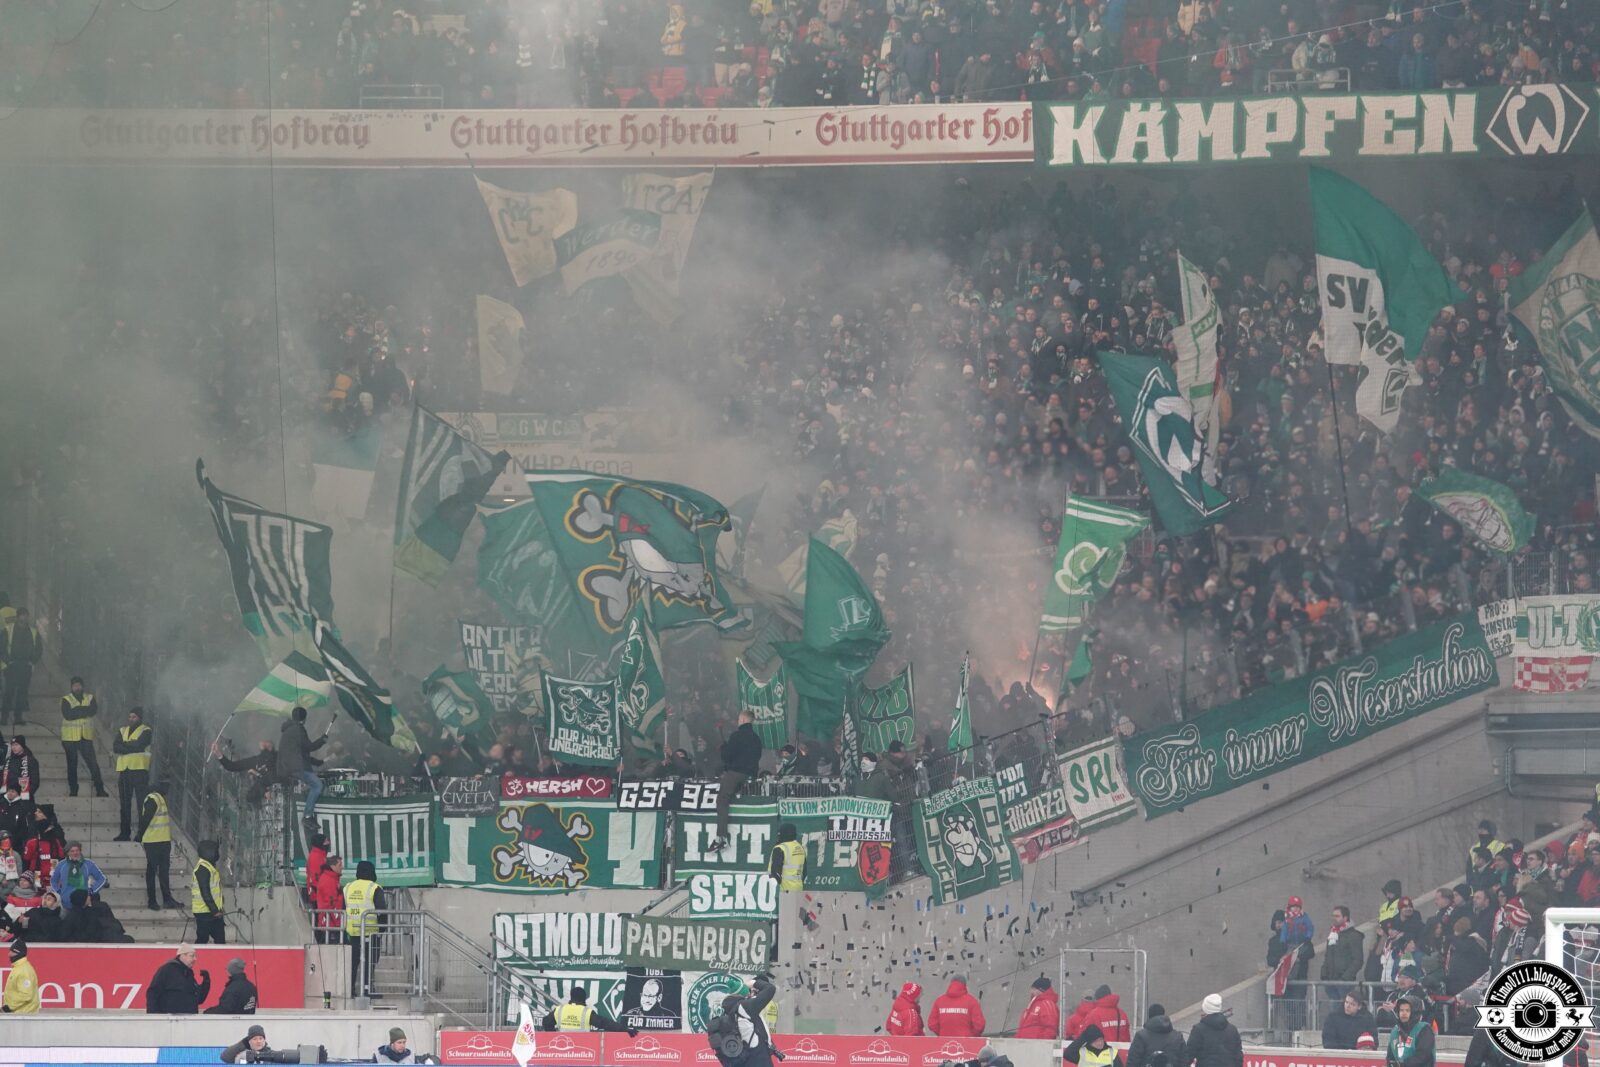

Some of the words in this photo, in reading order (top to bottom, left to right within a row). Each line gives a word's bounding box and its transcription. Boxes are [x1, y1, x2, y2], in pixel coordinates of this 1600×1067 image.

[80, 115, 243, 150] Stuttgarter
[250, 115, 371, 152] Hofbräu
[450, 115, 613, 154] Stuttgarter
[619, 113, 738, 149] Hofbräu
[815, 112, 975, 150] Stuttgarter
[981, 109, 1033, 145] Hof
[1048, 93, 1478, 165] KÄMPFEN
[1326, 273, 1369, 313] SV
[568, 455, 633, 476] Arena
[1136, 724, 1217, 807] Für
[1223, 714, 1307, 780] immer
[1310, 622, 1492, 743] Weserstadion
[548, 738, 621, 761] UNBREAKABLE
[558, 727, 579, 742] OUR
[526, 780, 583, 795] HERSH
[780, 801, 819, 816] SEKTION
[820, 800, 888, 816] STADIONVERBOT
[691, 874, 776, 912] SEKO
[497, 913, 622, 958] DETMOLD
[626, 920, 767, 964] PAPENBURG
[627, 1016, 647, 1029] FÜR
[649, 1017, 674, 1029] IMMER
[447, 1050, 512, 1059] Schwarzwaldmilch
[532, 1050, 594, 1059] chwarzwaldmilch
[615, 1051, 680, 1060] Schwarzwaldmilch
